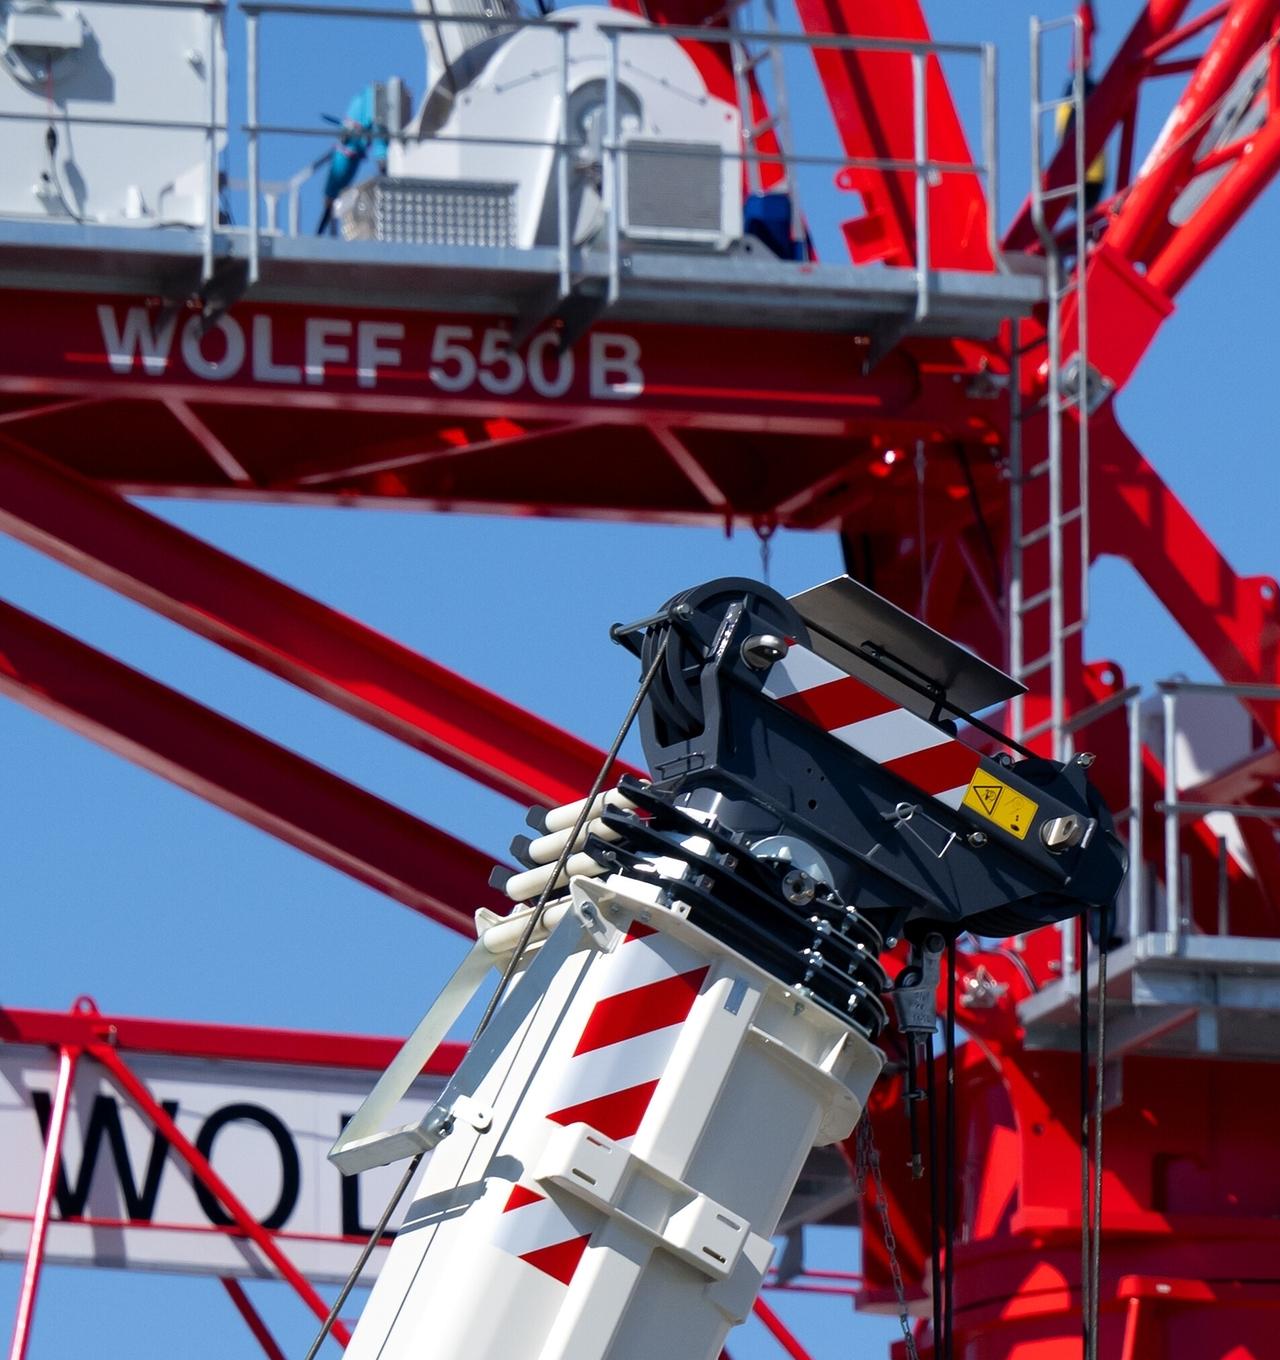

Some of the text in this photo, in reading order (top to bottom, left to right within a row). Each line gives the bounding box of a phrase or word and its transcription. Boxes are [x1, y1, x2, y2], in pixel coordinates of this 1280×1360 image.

[98, 304, 646, 399] WOLFF 550 B
